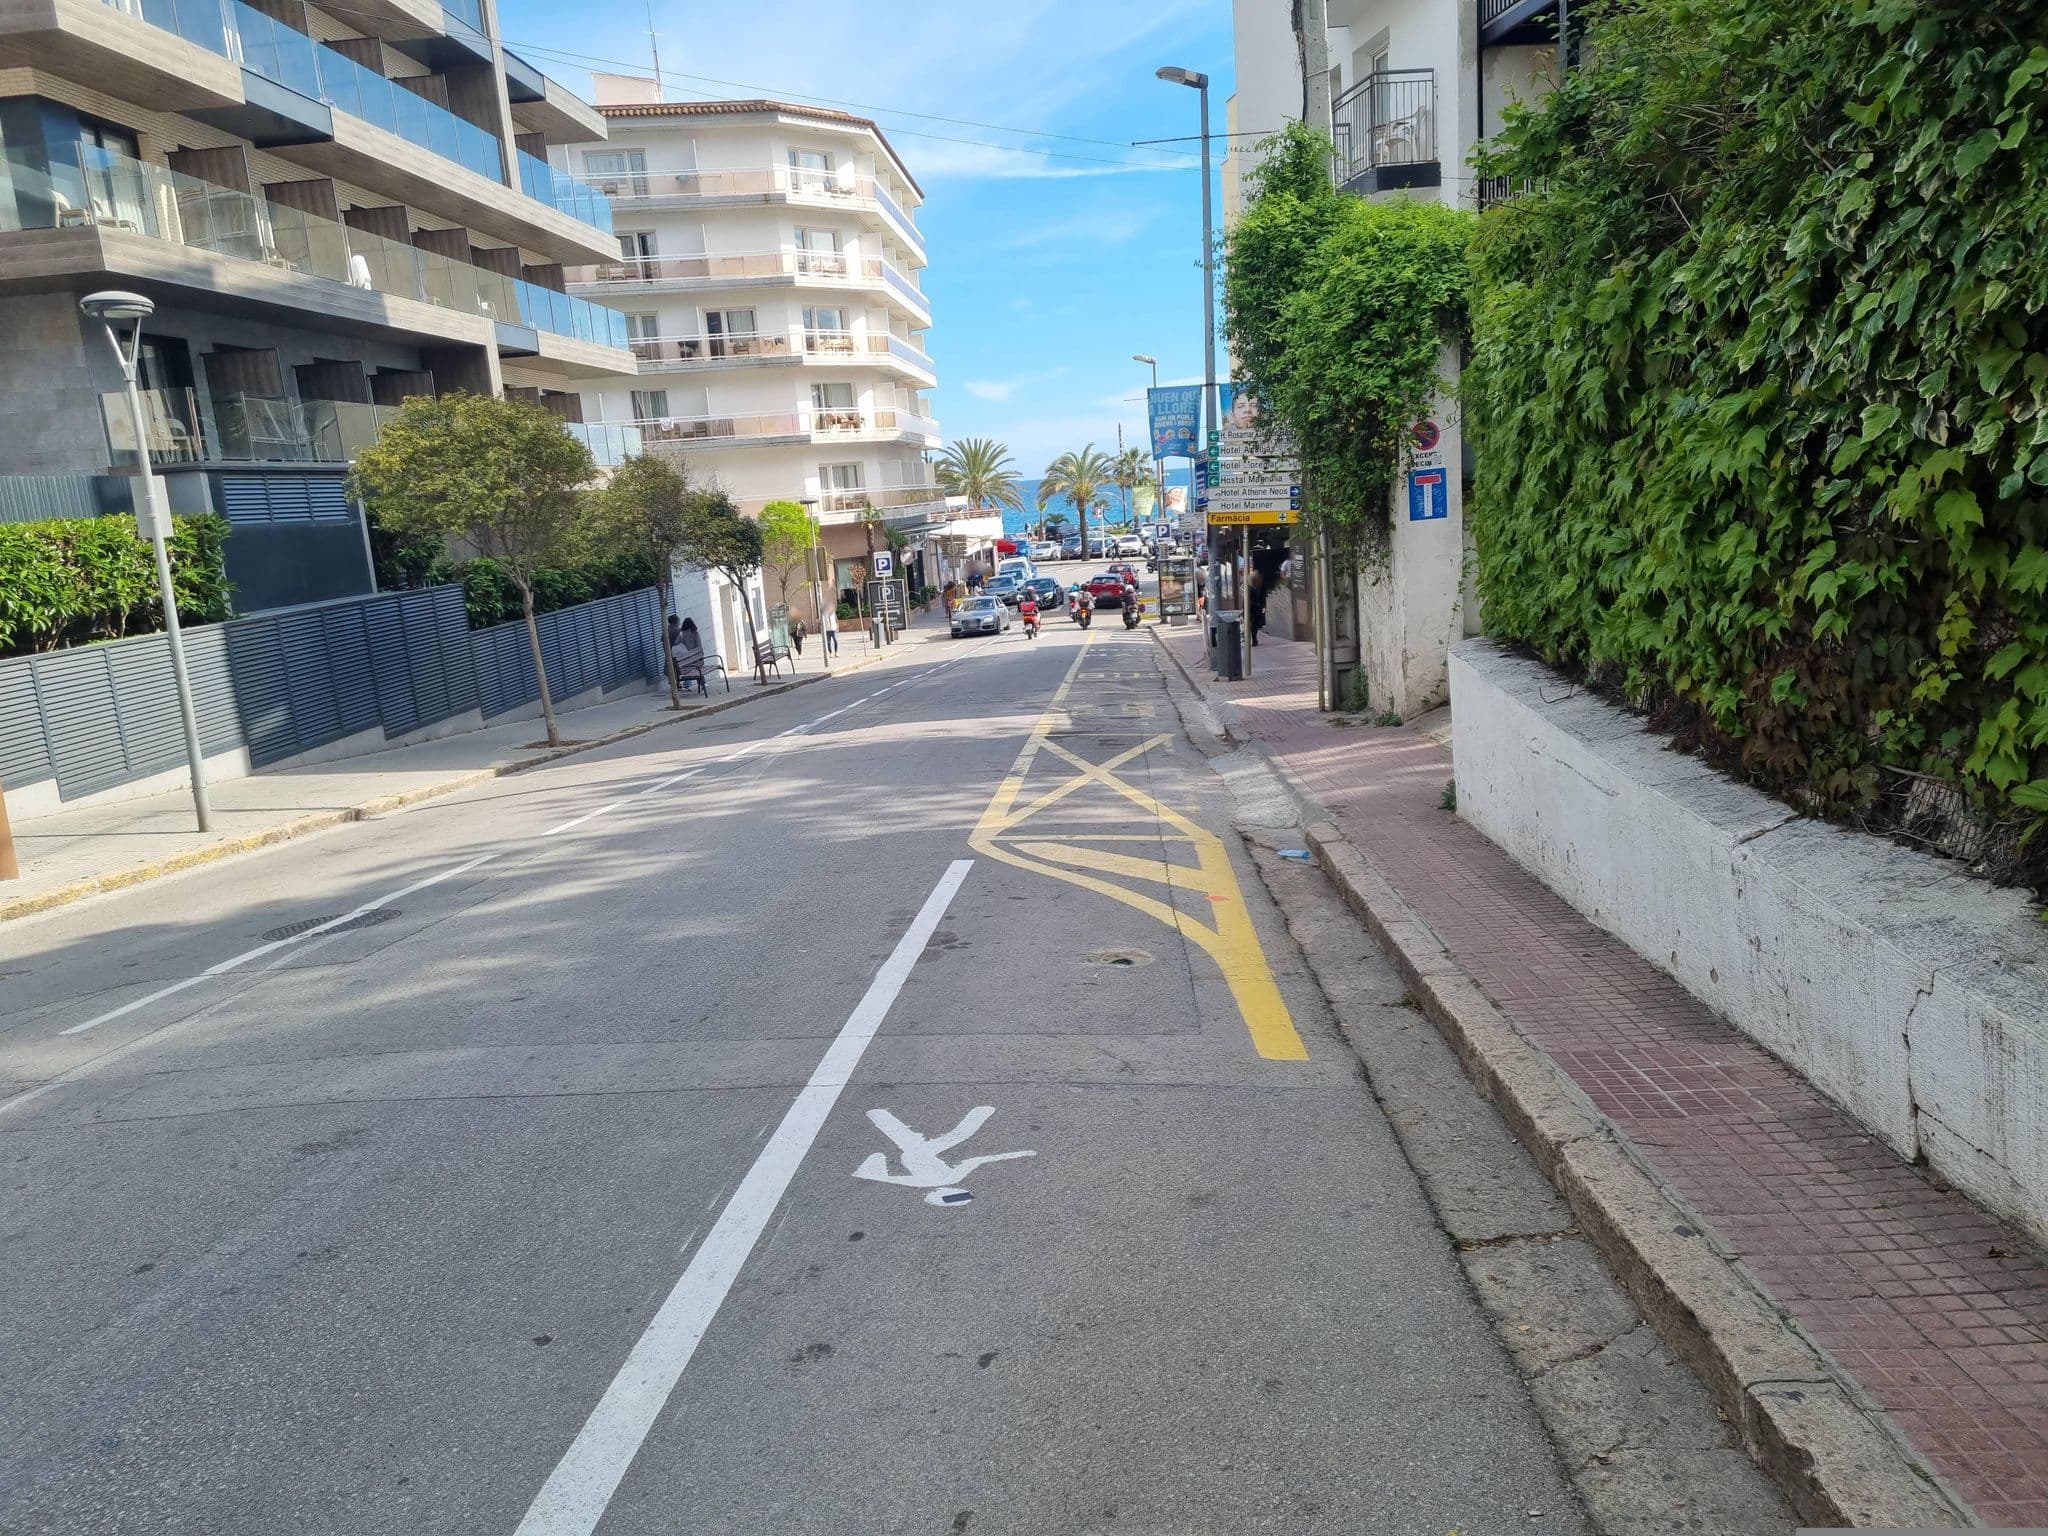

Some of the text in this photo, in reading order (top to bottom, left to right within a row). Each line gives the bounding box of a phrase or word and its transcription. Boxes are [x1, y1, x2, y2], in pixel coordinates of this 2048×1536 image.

[1221, 447, 1241, 455] Hotel
[1221, 462, 1241, 470] Hotel
[1221, 474, 1283, 484] Hostal Magnolia
[1221, 487, 1288, 497] Hotel Athene Neos
[1221, 500, 1273, 510] Hotel Mariner
[1211, 513, 1251, 523] Farmàcia
[1157, 525, 1168, 537] P
[877, 558, 888, 570] P
[882, 587, 892, 600] P
